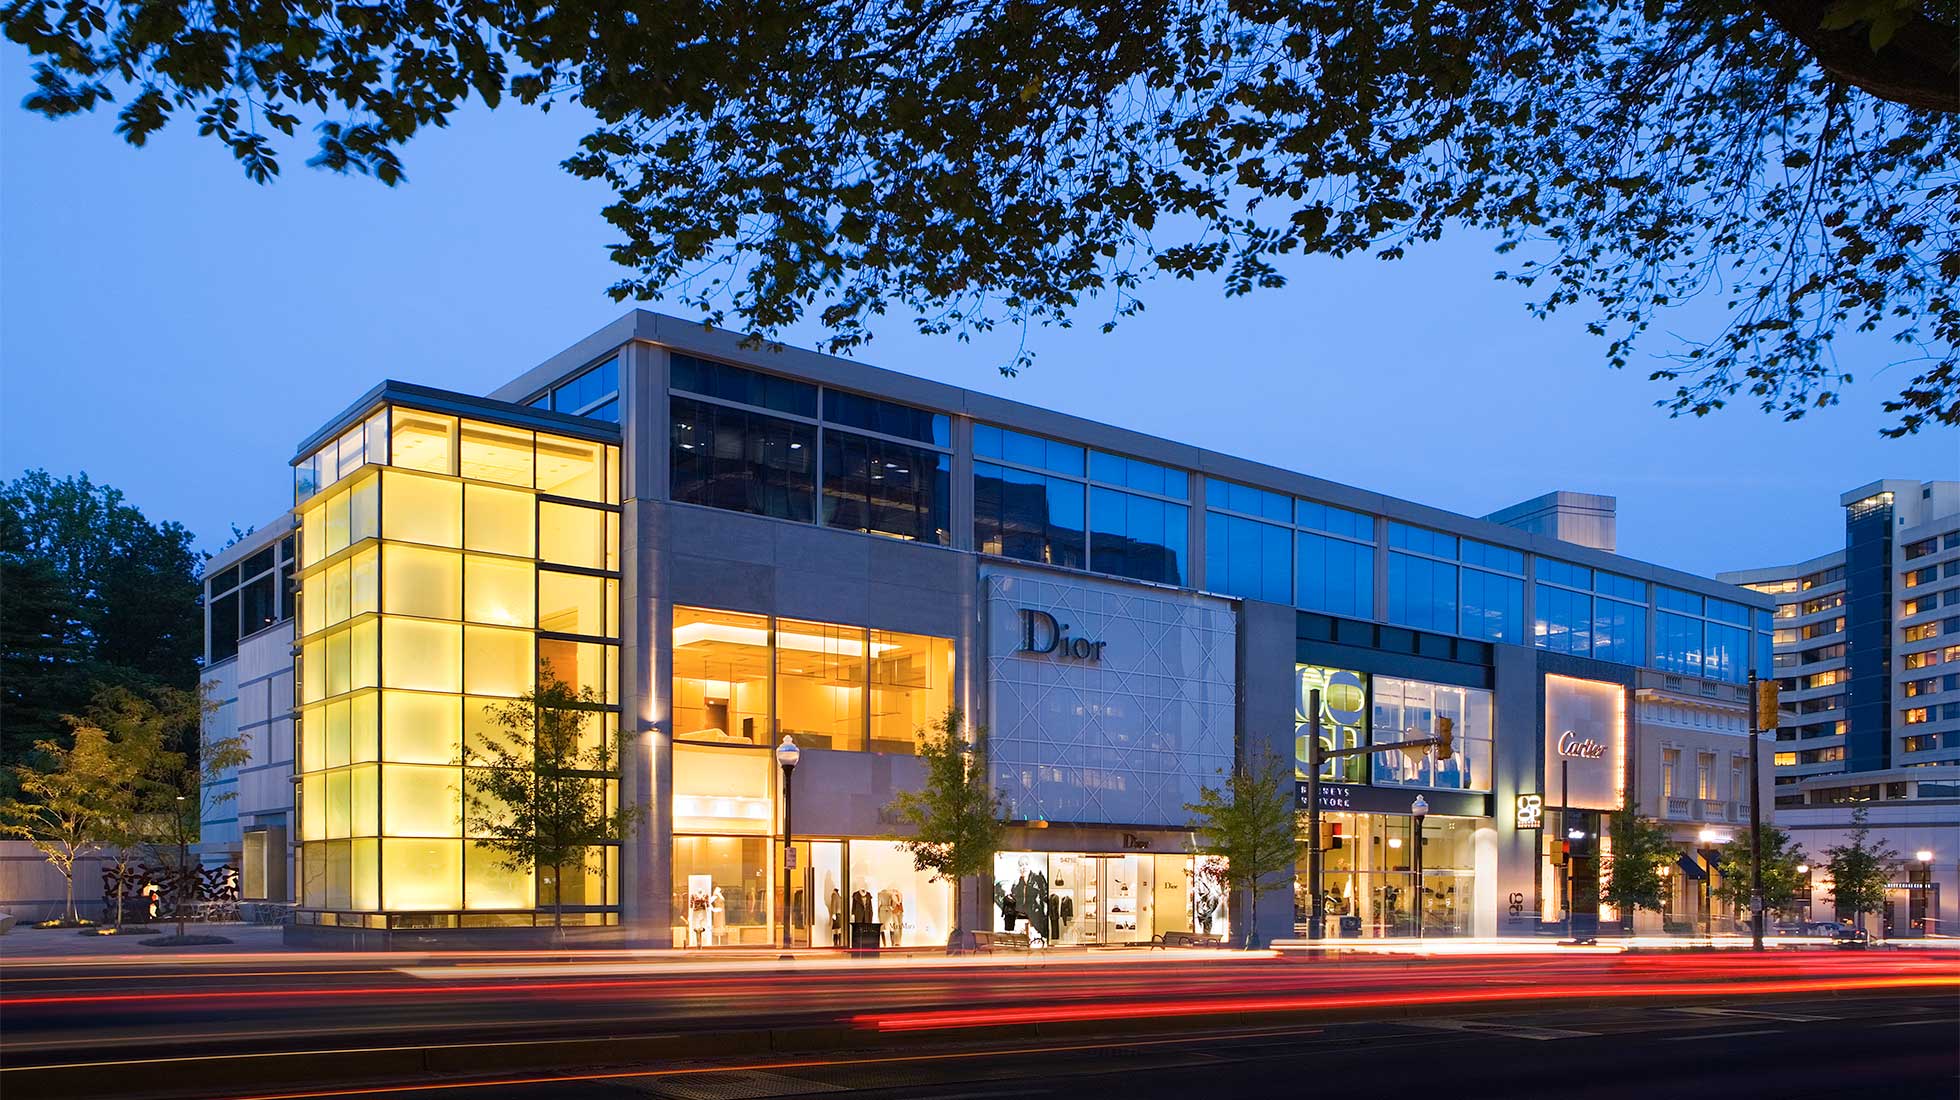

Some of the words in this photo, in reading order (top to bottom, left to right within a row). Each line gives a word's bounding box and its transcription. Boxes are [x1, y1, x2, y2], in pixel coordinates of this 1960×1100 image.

[1017, 608, 1107, 660] Dior
[1558, 731, 1608, 759] Cartier
[1301, 786, 1350, 797] BNEYS
